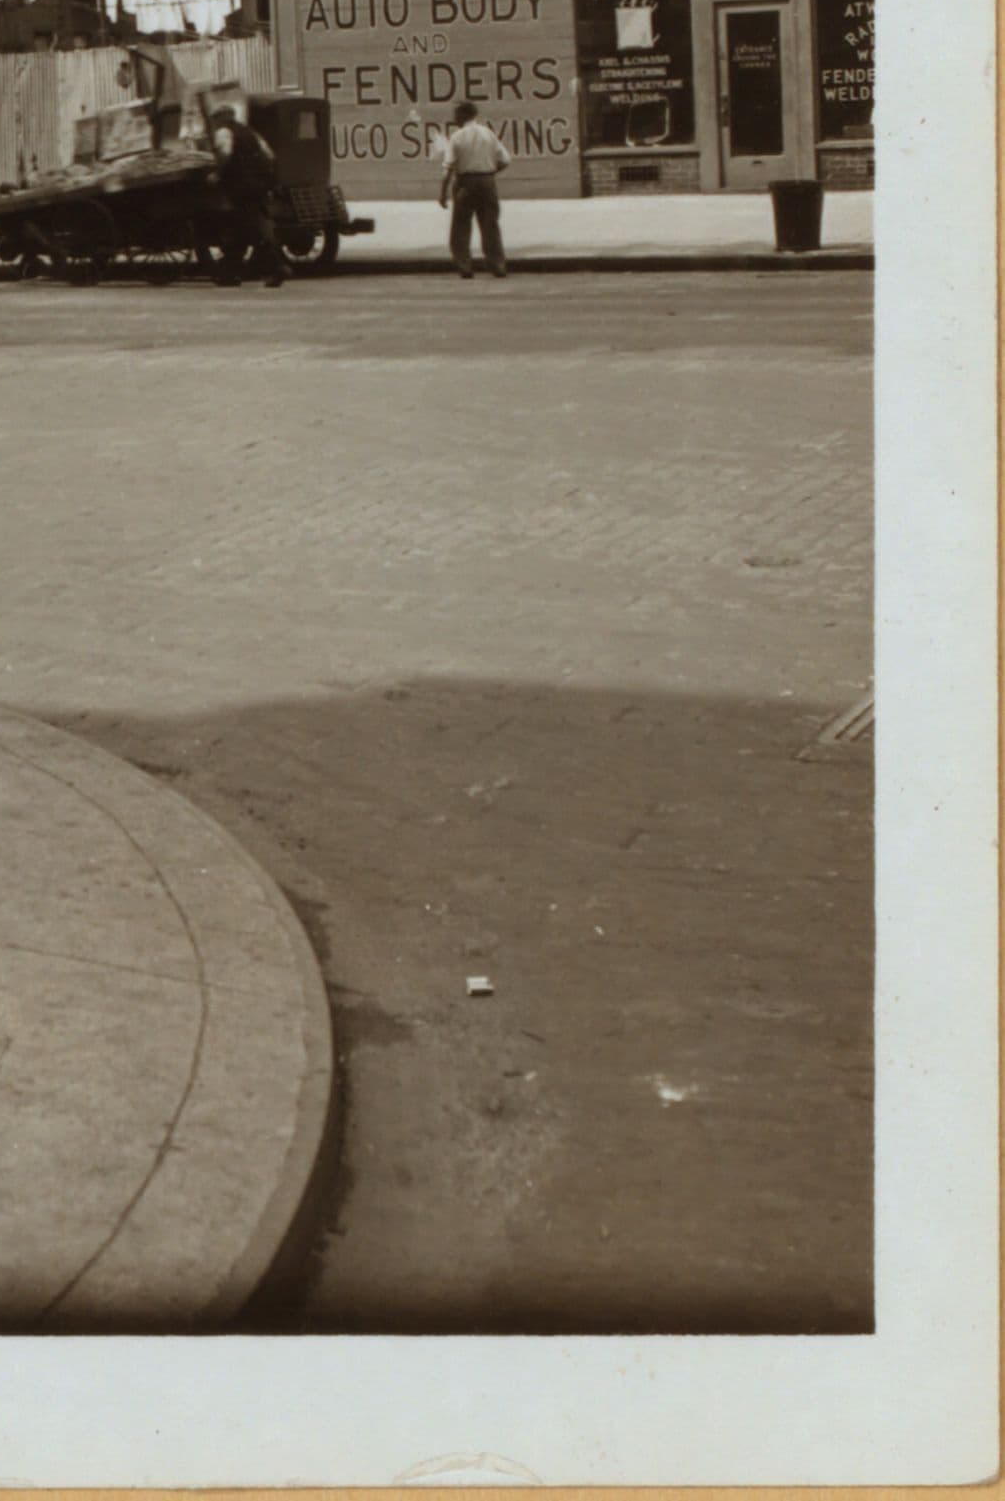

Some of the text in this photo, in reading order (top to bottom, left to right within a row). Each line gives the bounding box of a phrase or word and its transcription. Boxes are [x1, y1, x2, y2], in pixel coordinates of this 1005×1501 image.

[393, 33, 449, 54] AND
[322, 57, 561, 105] FENDERS
[330, 117, 572, 160] UCO SPYING
